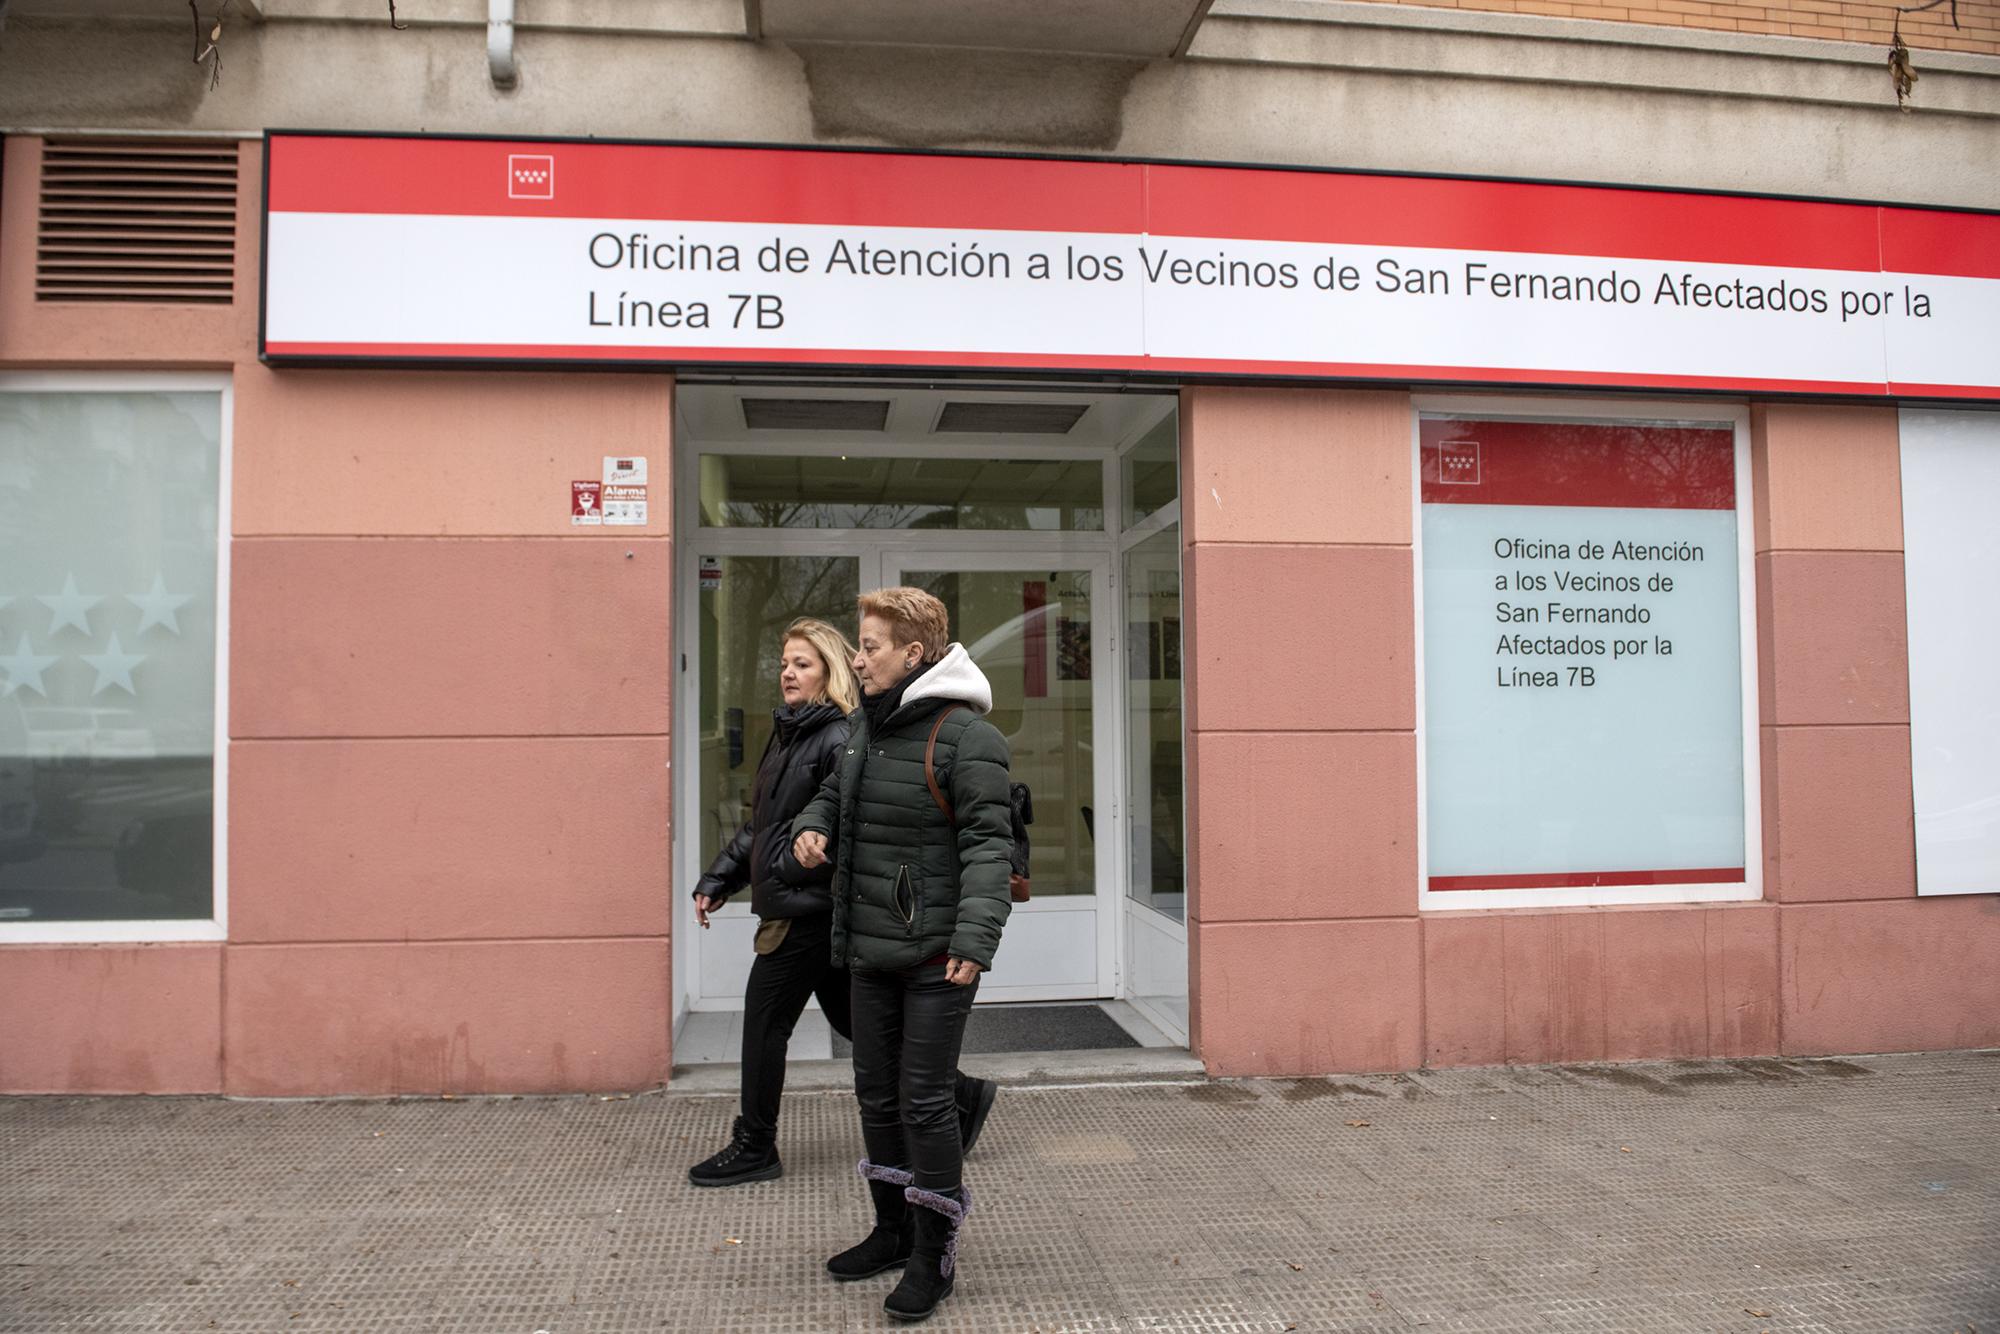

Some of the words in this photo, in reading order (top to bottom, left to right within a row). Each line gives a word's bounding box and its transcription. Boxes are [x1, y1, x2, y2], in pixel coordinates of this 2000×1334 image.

[589, 233, 740, 272] Oficina
[758, 237, 809, 273] de
[825, 239, 1010, 278] Atención
[1027, 253, 1050, 279] a
[1067, 245, 1123, 281] los
[1138, 247, 1298, 288] Vecinos
[1313, 257, 1360, 291] de
[1375, 259, 1449, 295] San
[1466, 263, 1641, 304] Fernando
[1654, 273, 1828, 313] Afectados
[1841, 290, 1894, 323] por
[1905, 285, 1931, 318] la
[589, 291, 709, 328] Línea
[728, 294, 784, 329] 7B
[604, 486, 646, 496] Alarma
[1494, 537, 1571, 560] Oficina
[1578, 540, 1605, 561] de
[1611, 540, 1704, 562] Atención
[1495, 575, 1508, 591] a
[1516, 570, 1547, 592] los
[1553, 570, 1641, 593] Vecinos
[1647, 572, 1674, 593] de
[1496, 601, 1539, 623] San
[1547, 602, 1651, 624] Fernando
[1496, 634, 1606, 656] Afectados
[1613, 639, 1649, 660] por
[1654, 635, 1673, 656] la
[1497, 666, 1559, 688] Línea
[1566, 666, 1596, 687] 7B
